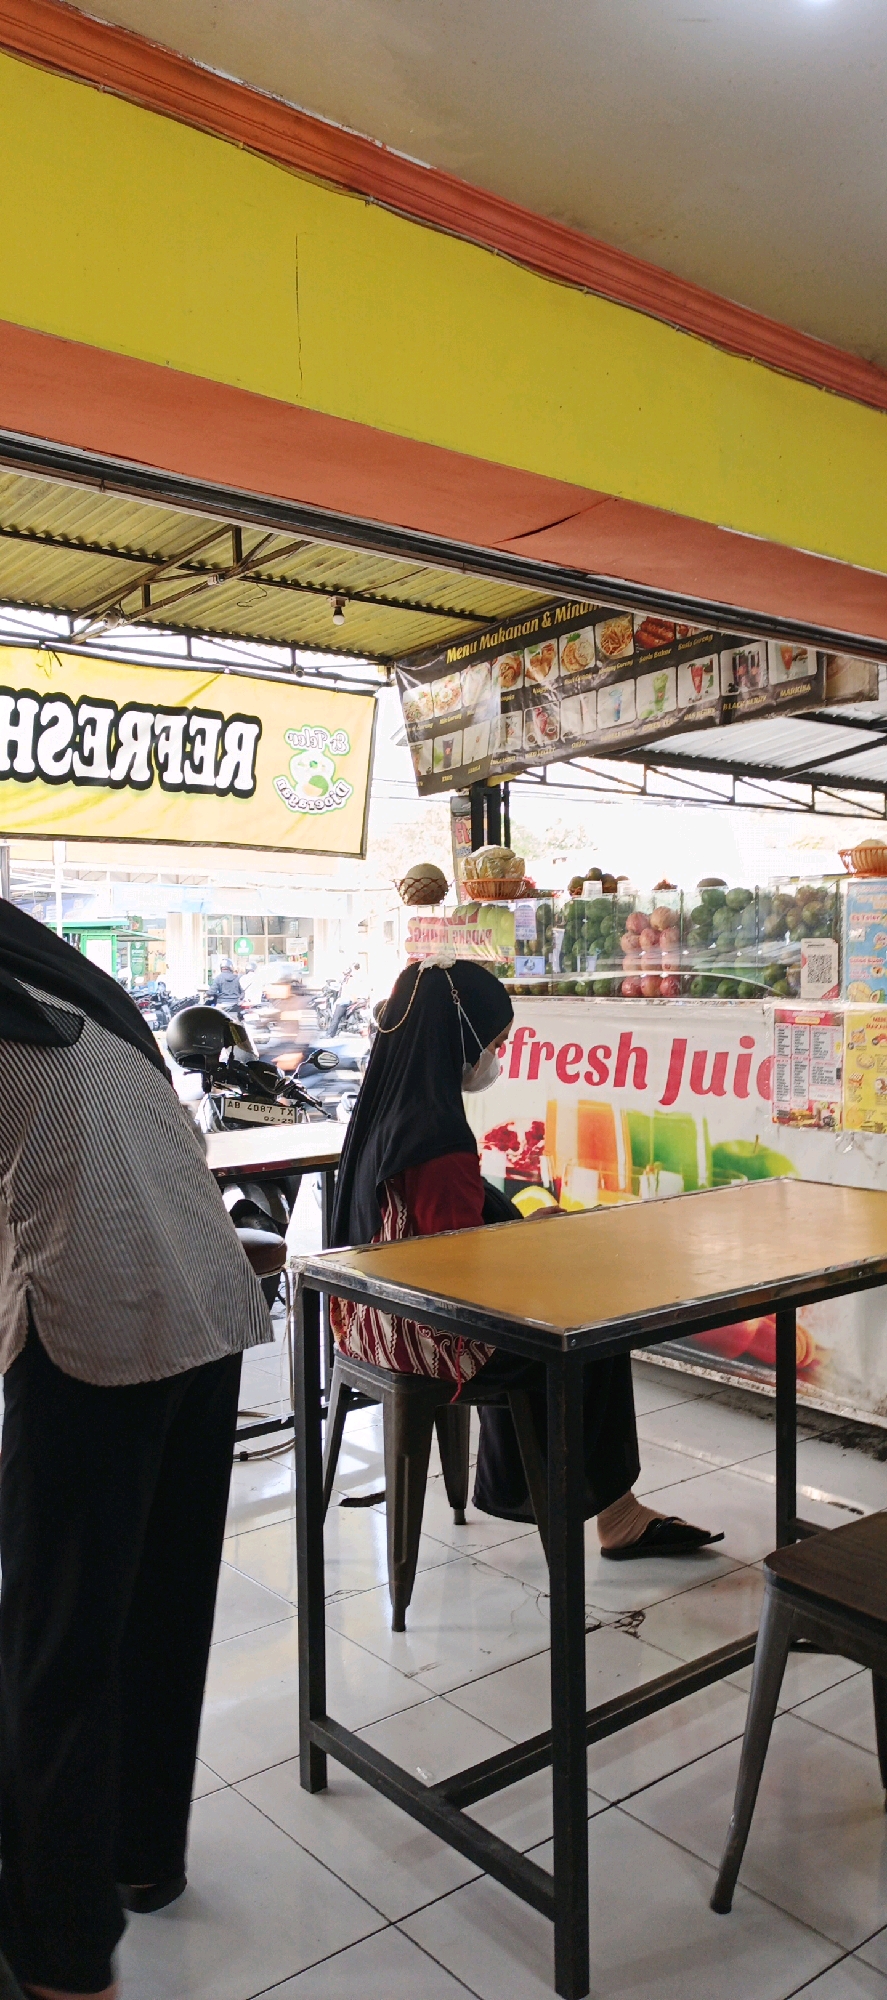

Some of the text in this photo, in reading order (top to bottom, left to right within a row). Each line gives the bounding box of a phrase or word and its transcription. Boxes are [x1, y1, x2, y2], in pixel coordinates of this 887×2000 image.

[446, 640, 478, 664] Menu
[479, 617, 539, 650] Makanan
[541, 611, 552, 628] &
[227, 1100, 294, 1117] AB 4087 TX
